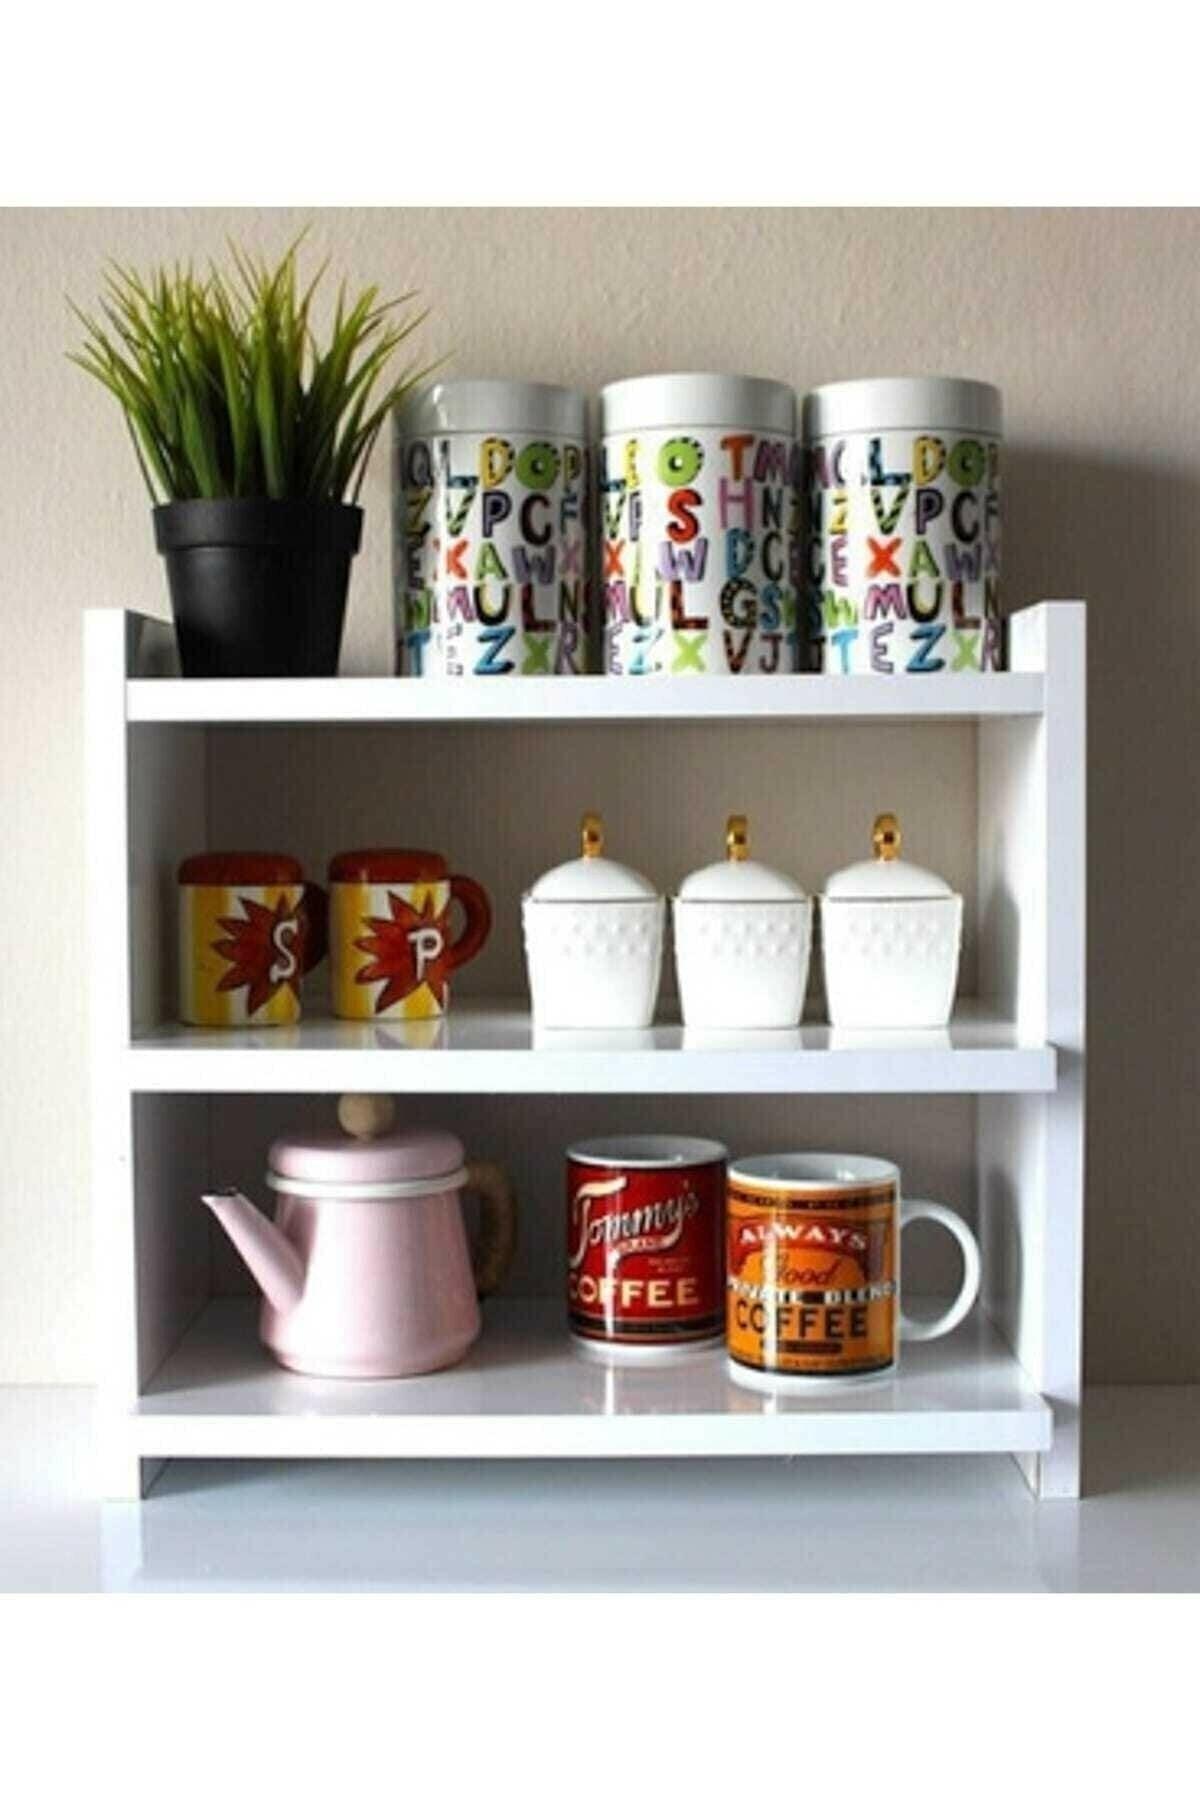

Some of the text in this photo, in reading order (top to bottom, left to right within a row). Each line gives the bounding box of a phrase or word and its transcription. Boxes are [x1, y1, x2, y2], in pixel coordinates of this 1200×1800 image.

[269, 919, 298, 984] S
[407, 928, 444, 982] P
[740, 1219, 868, 1250] ALWAYS
[735, 1300, 869, 1340] COFFEE
